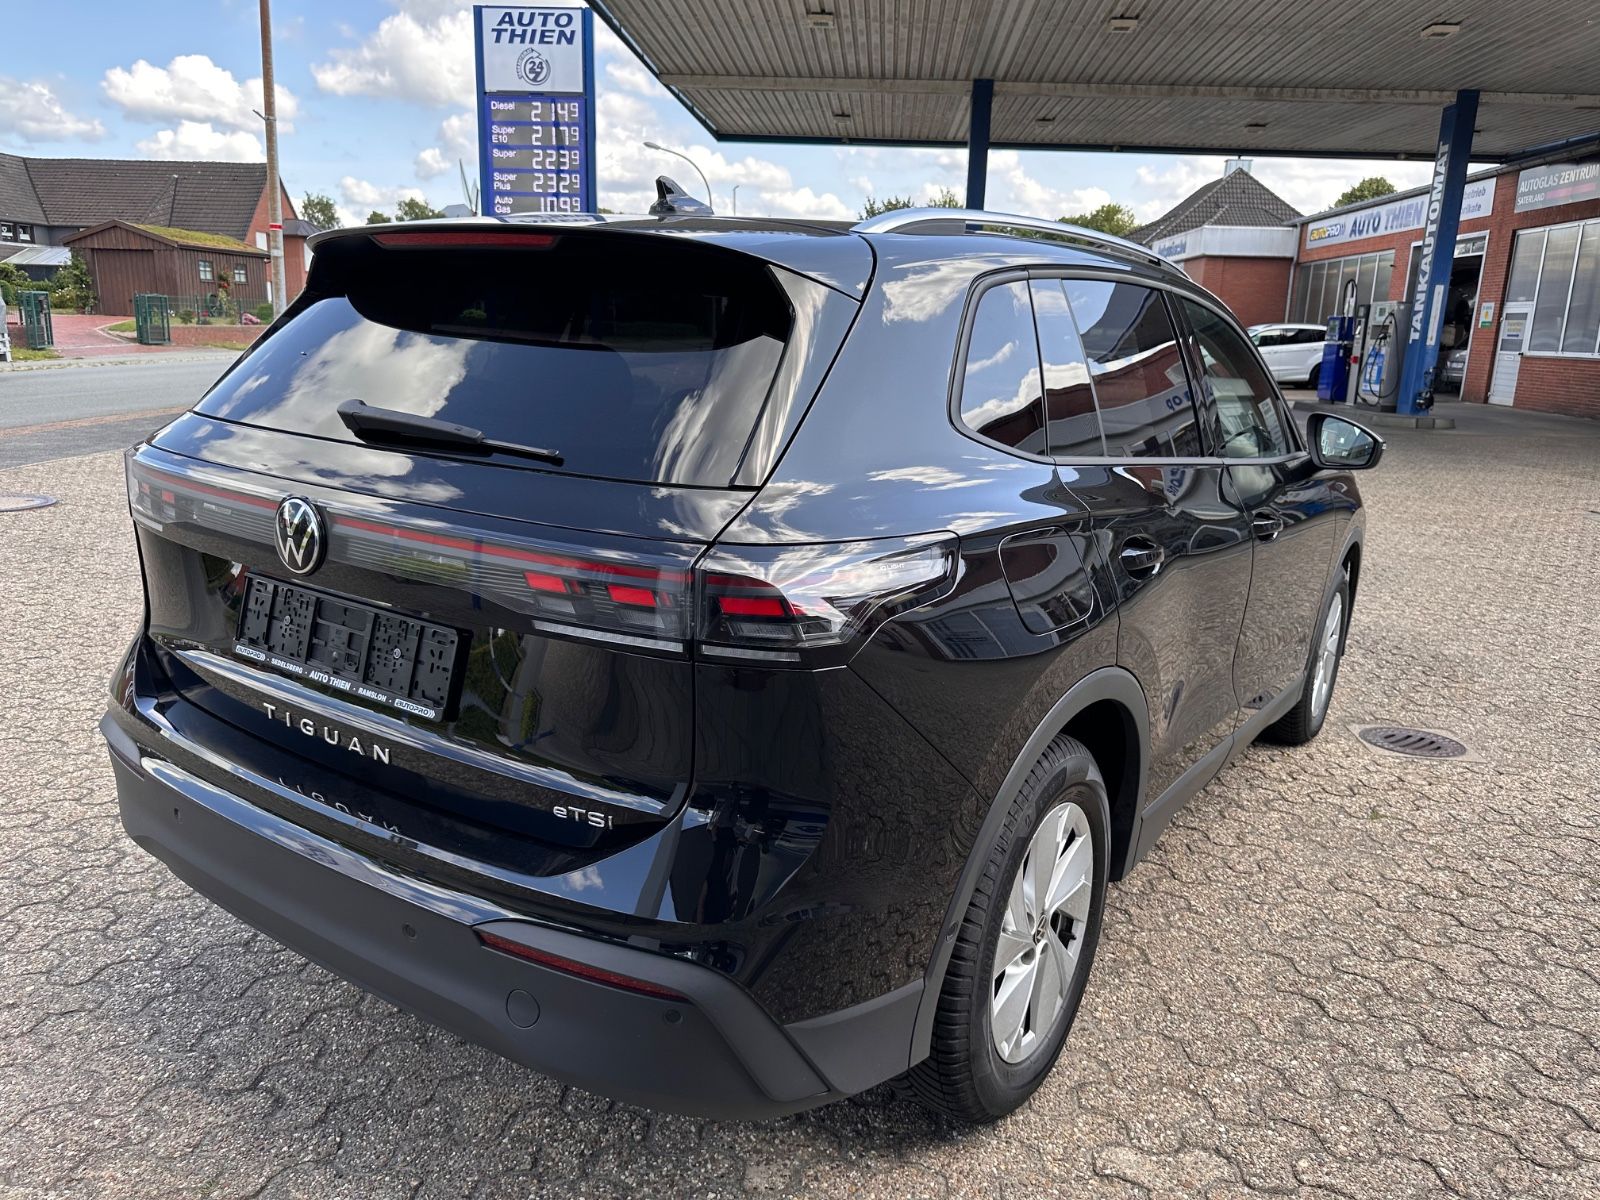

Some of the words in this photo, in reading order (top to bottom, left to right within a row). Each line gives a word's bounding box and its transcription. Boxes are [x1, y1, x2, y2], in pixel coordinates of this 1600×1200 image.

[496, 11, 574, 28] AUTO
[491, 28, 576, 45] THIEN
[528, 60, 544, 72] 24
[490, 100, 516, 111] Diesel
[491, 125, 516, 135] Super
[491, 134, 508, 143] E10
[492, 149, 517, 159] Super
[493, 172, 518, 183] Super
[1519, 173, 1559, 194] AUTOGLAS
[1559, 163, 1600, 185] ZENTRUM
[493, 181, 512, 191] Plus
[494, 195, 514, 205] Auto
[1516, 192, 1546, 206] SATERLAND
[494, 204, 512, 214] Gas
[1348, 210, 1382, 238] AUTO
[1384, 201, 1424, 231] THIEN
[1408, 141, 1450, 344] TANKAUTOMAT
[271, 658, 303, 674] SEDELSBERG
[308, 670, 329, 684] AUTO
[329, 676, 352, 691] THIEN
[358, 687, 387, 703] RAMSLOH
[263, 702, 390, 764] TIGUAN
